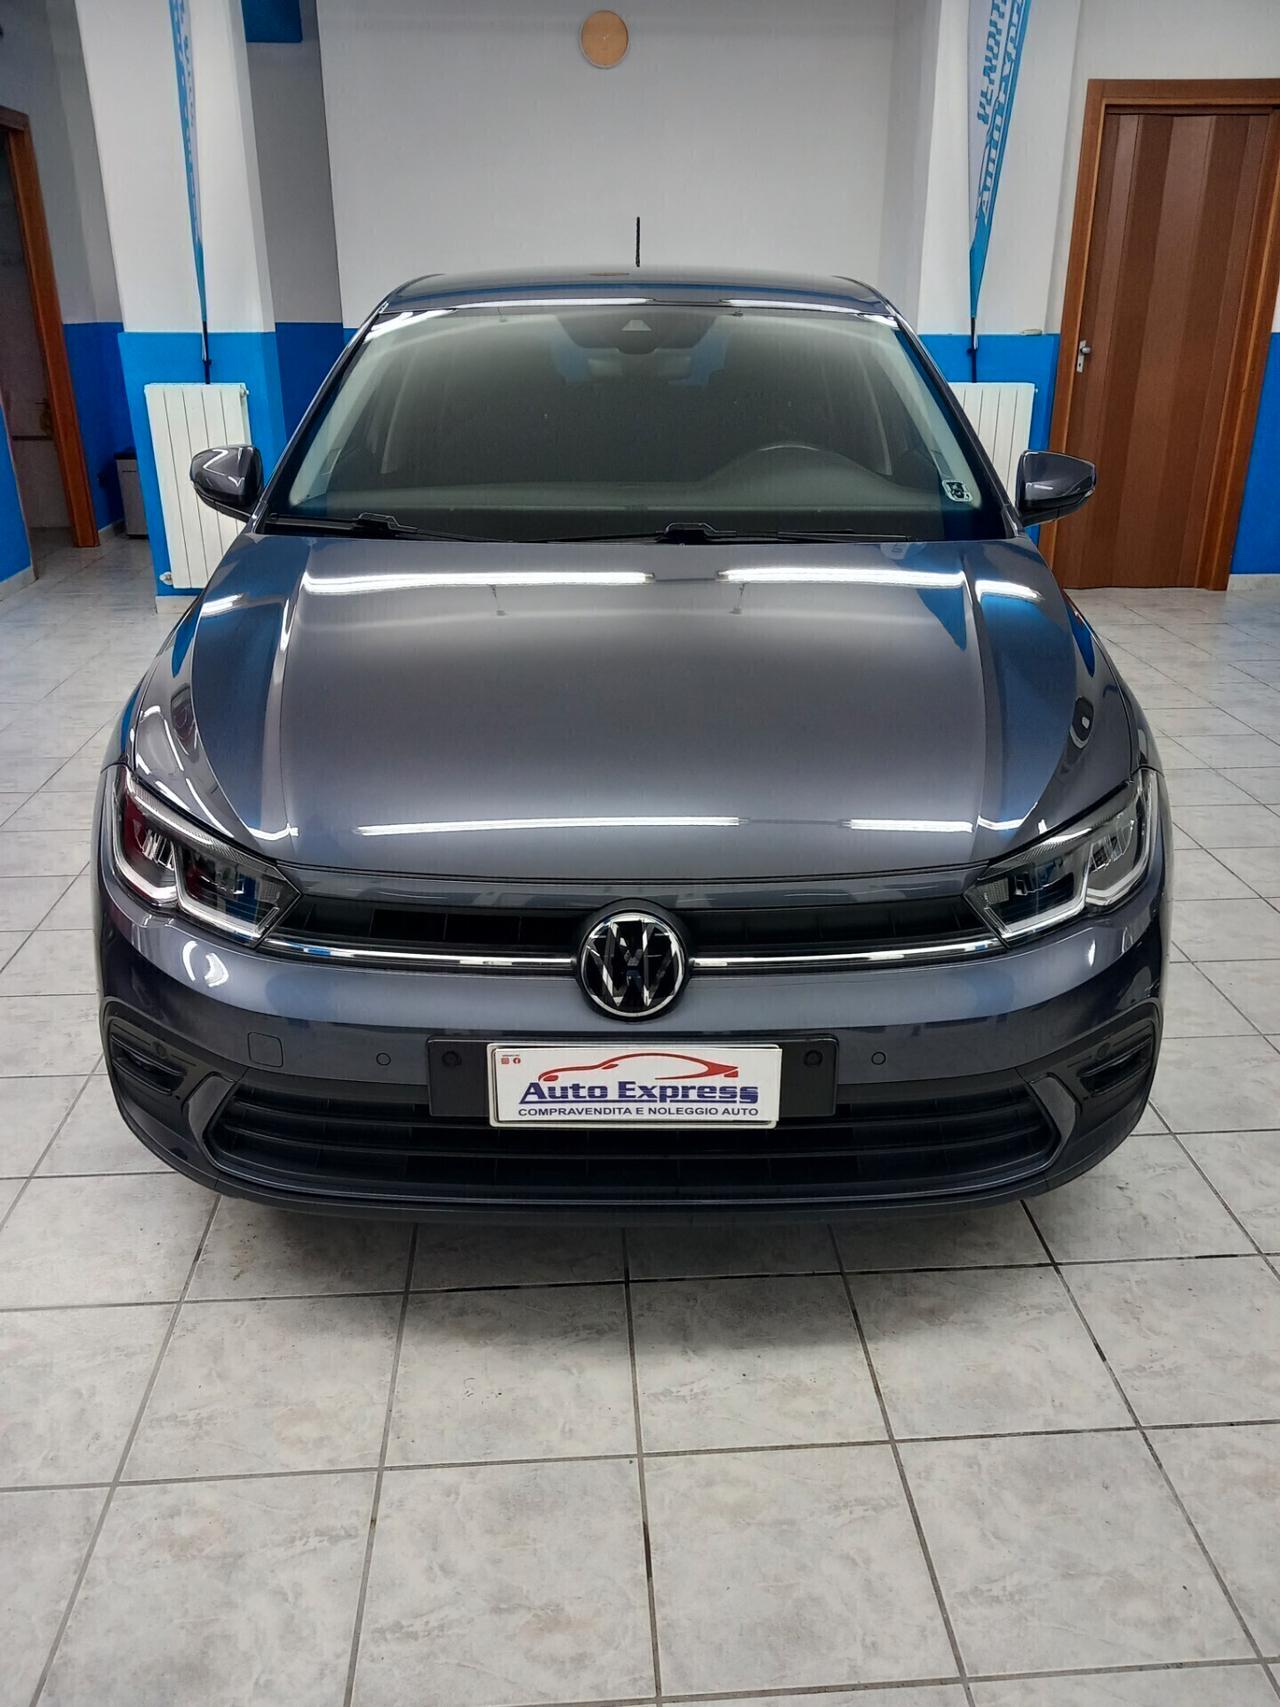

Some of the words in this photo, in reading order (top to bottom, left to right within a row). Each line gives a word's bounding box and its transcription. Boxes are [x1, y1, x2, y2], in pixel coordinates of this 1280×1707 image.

[977, 0, 1006, 125] VENDIT
[1000, 0, 1023, 104] Expr
[518, 1106, 633, 1117] COMPRAVENDITA
[635, 1106, 644, 1116] E
[647, 1106, 719, 1117] NOLEGGIO
[722, 1107, 759, 1117] AUTO
[519, 1081, 609, 1102] Auto
[617, 1080, 759, 1104] Express
